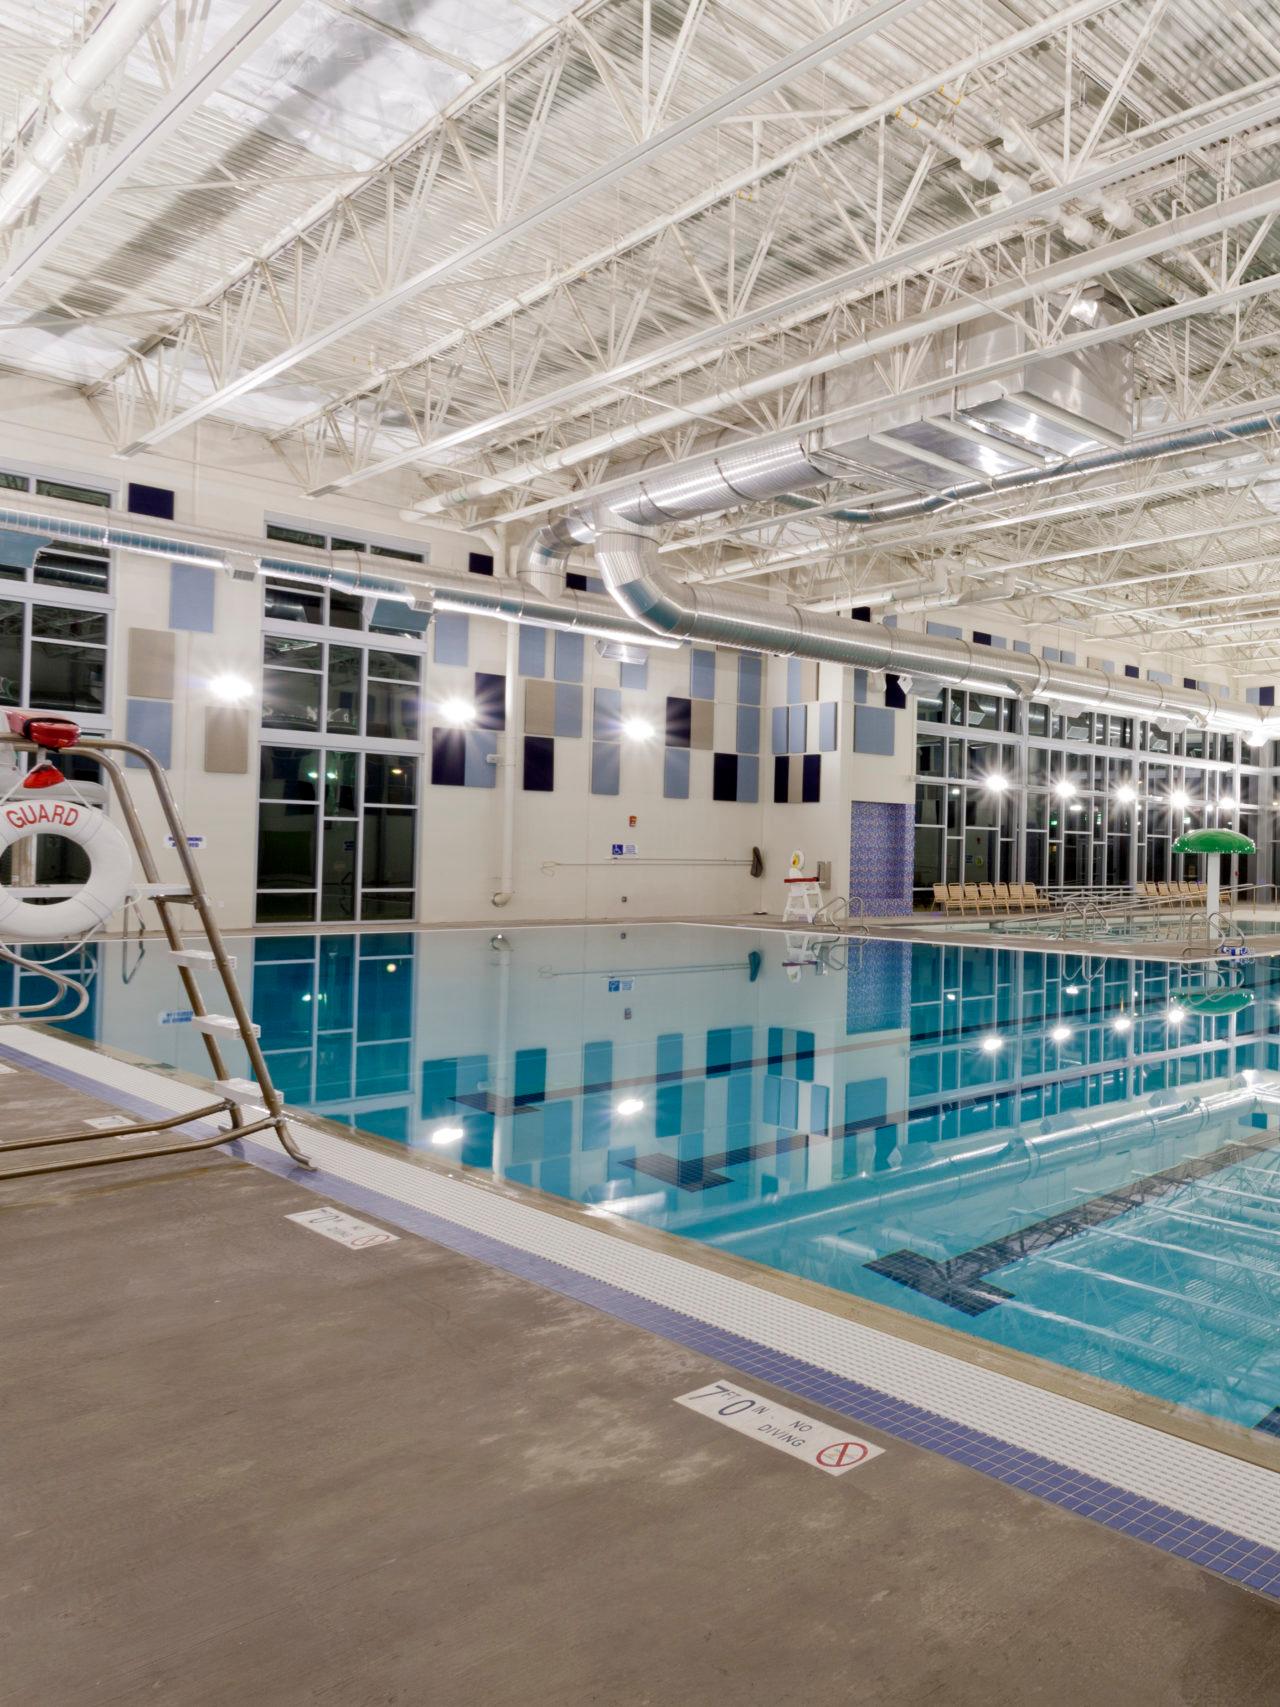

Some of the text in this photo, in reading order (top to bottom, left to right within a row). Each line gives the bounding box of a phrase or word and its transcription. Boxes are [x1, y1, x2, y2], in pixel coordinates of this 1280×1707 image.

[6, 803, 79, 829] GUARD
[757, 1423, 806, 1448] DIVING
[789, 1420, 813, 1433] NO
